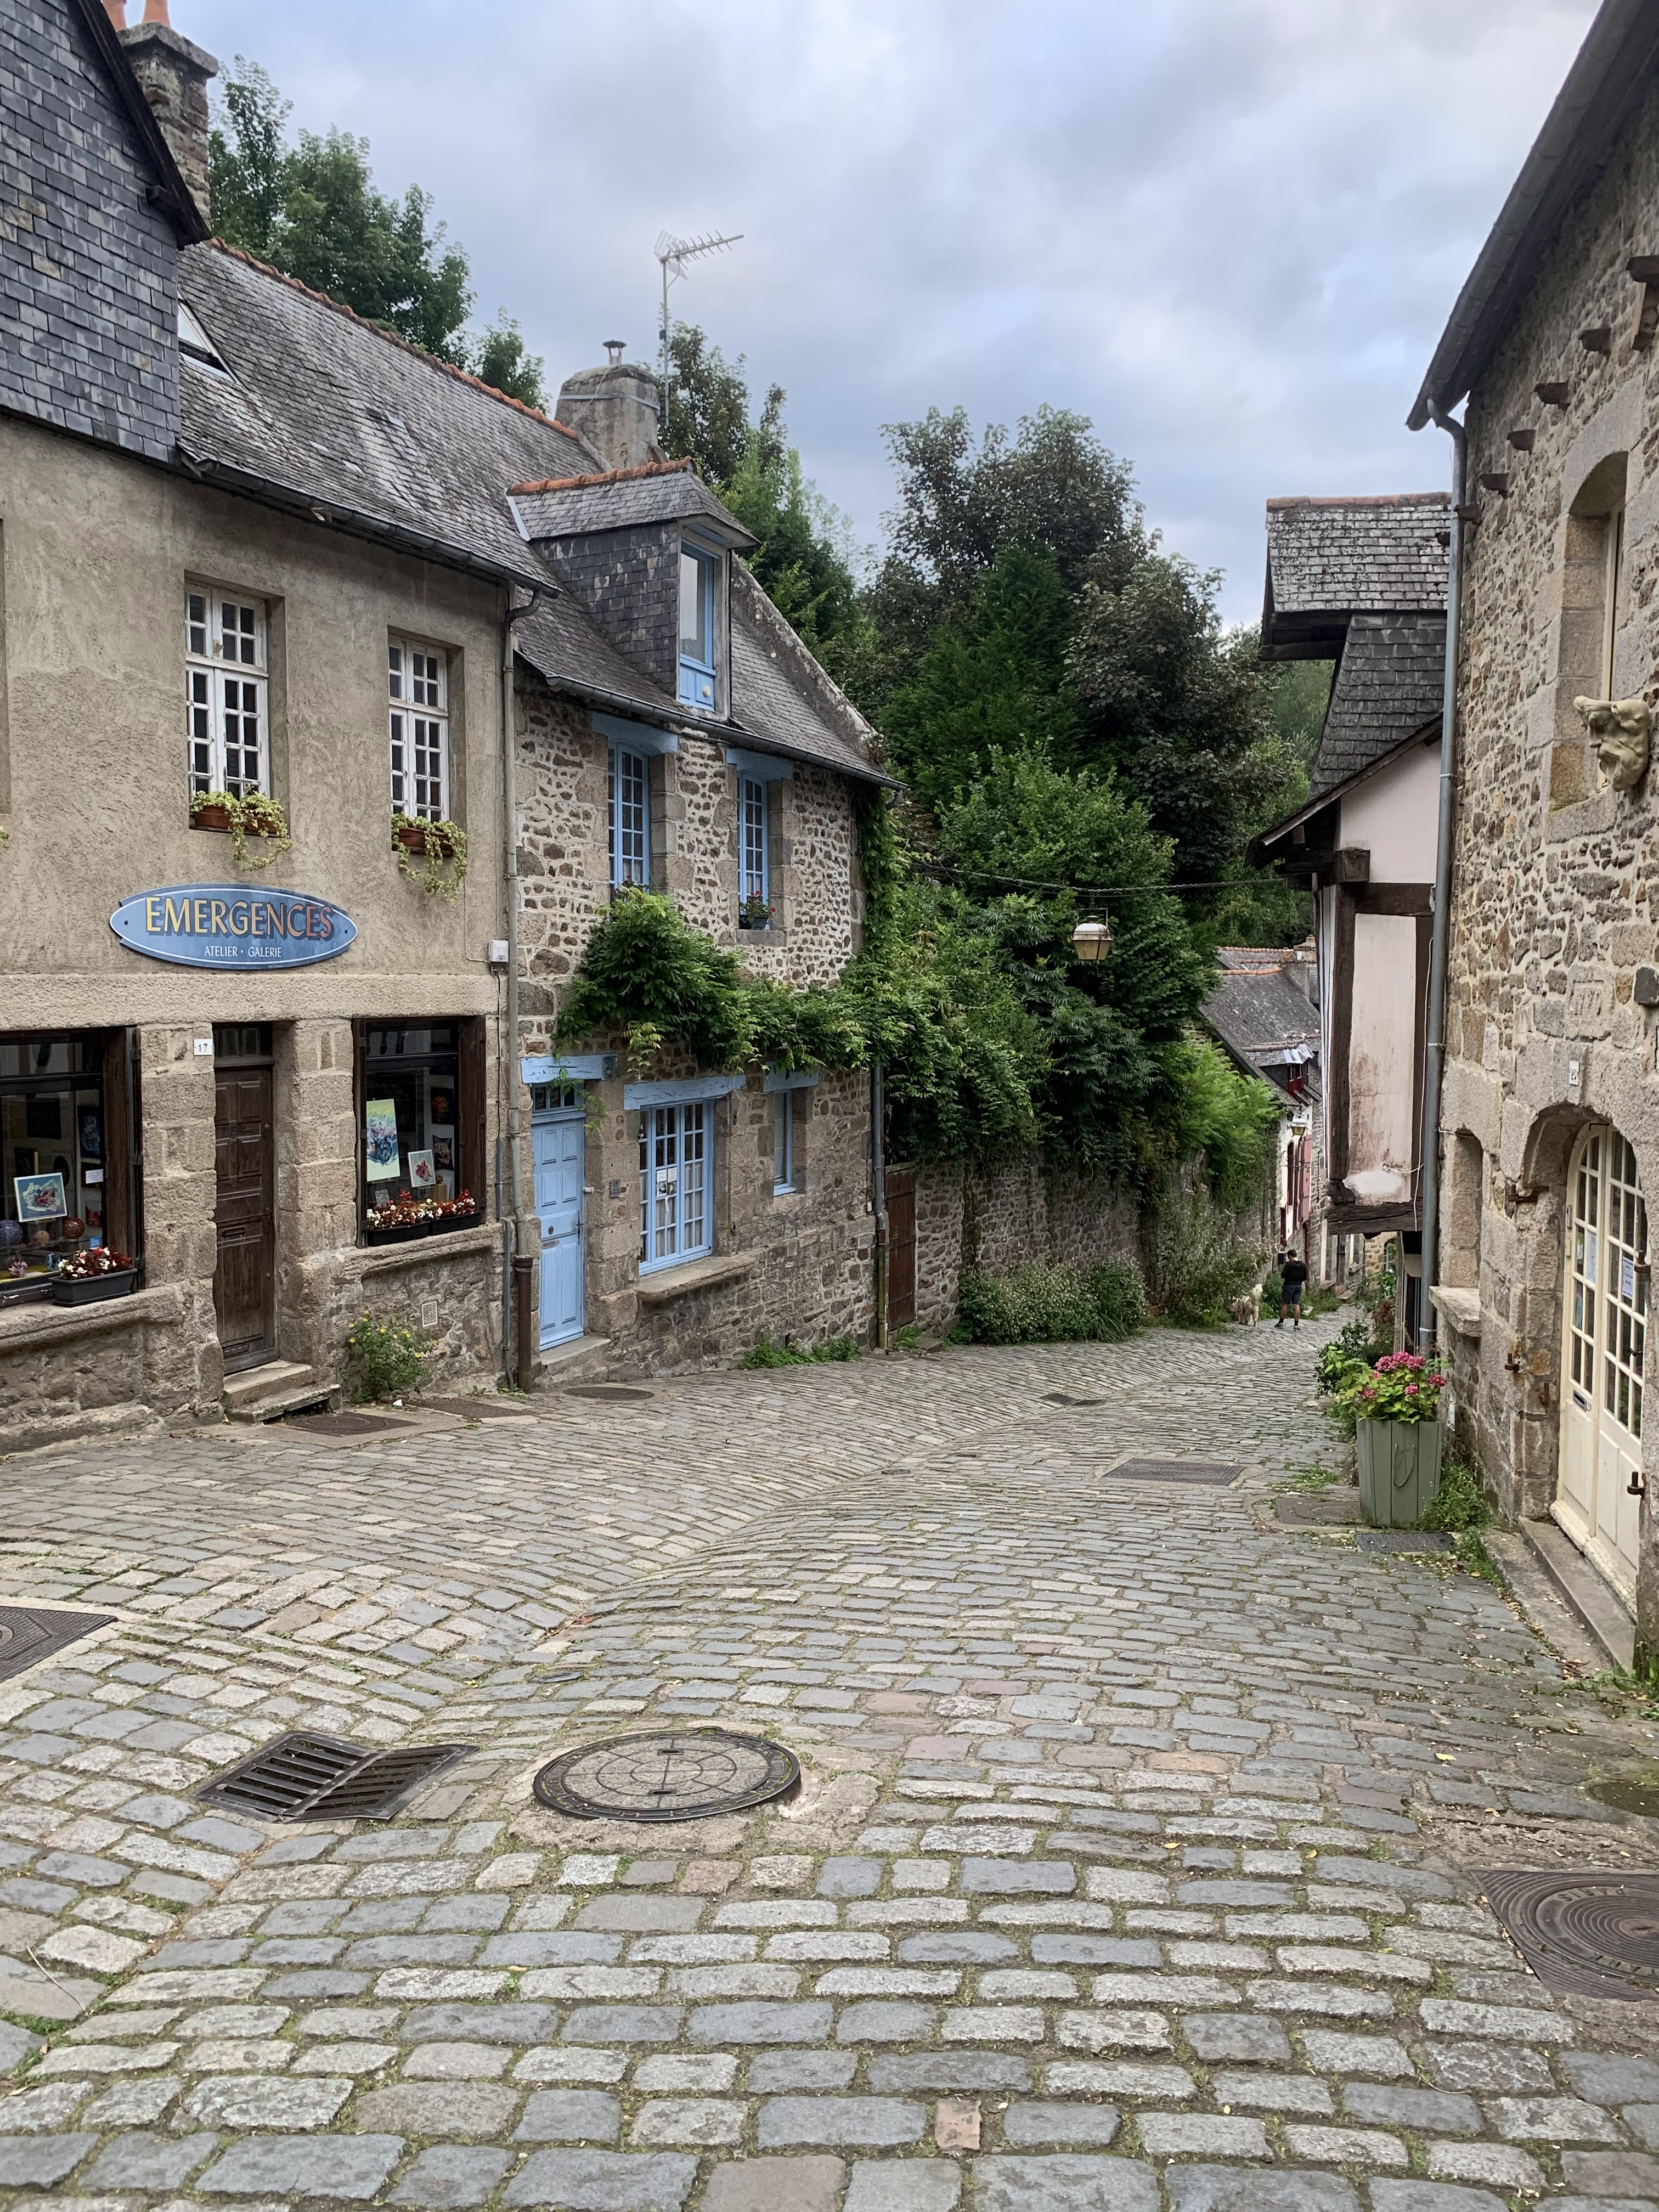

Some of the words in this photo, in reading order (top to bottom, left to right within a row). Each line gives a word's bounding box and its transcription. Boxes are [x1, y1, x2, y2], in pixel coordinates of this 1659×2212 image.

[145, 896, 334, 939] EMERGENCES
[204, 946, 238, 958] ATELIER
[247, 946, 282, 958] GALERIE
[198, 1043, 208, 1053] 17
